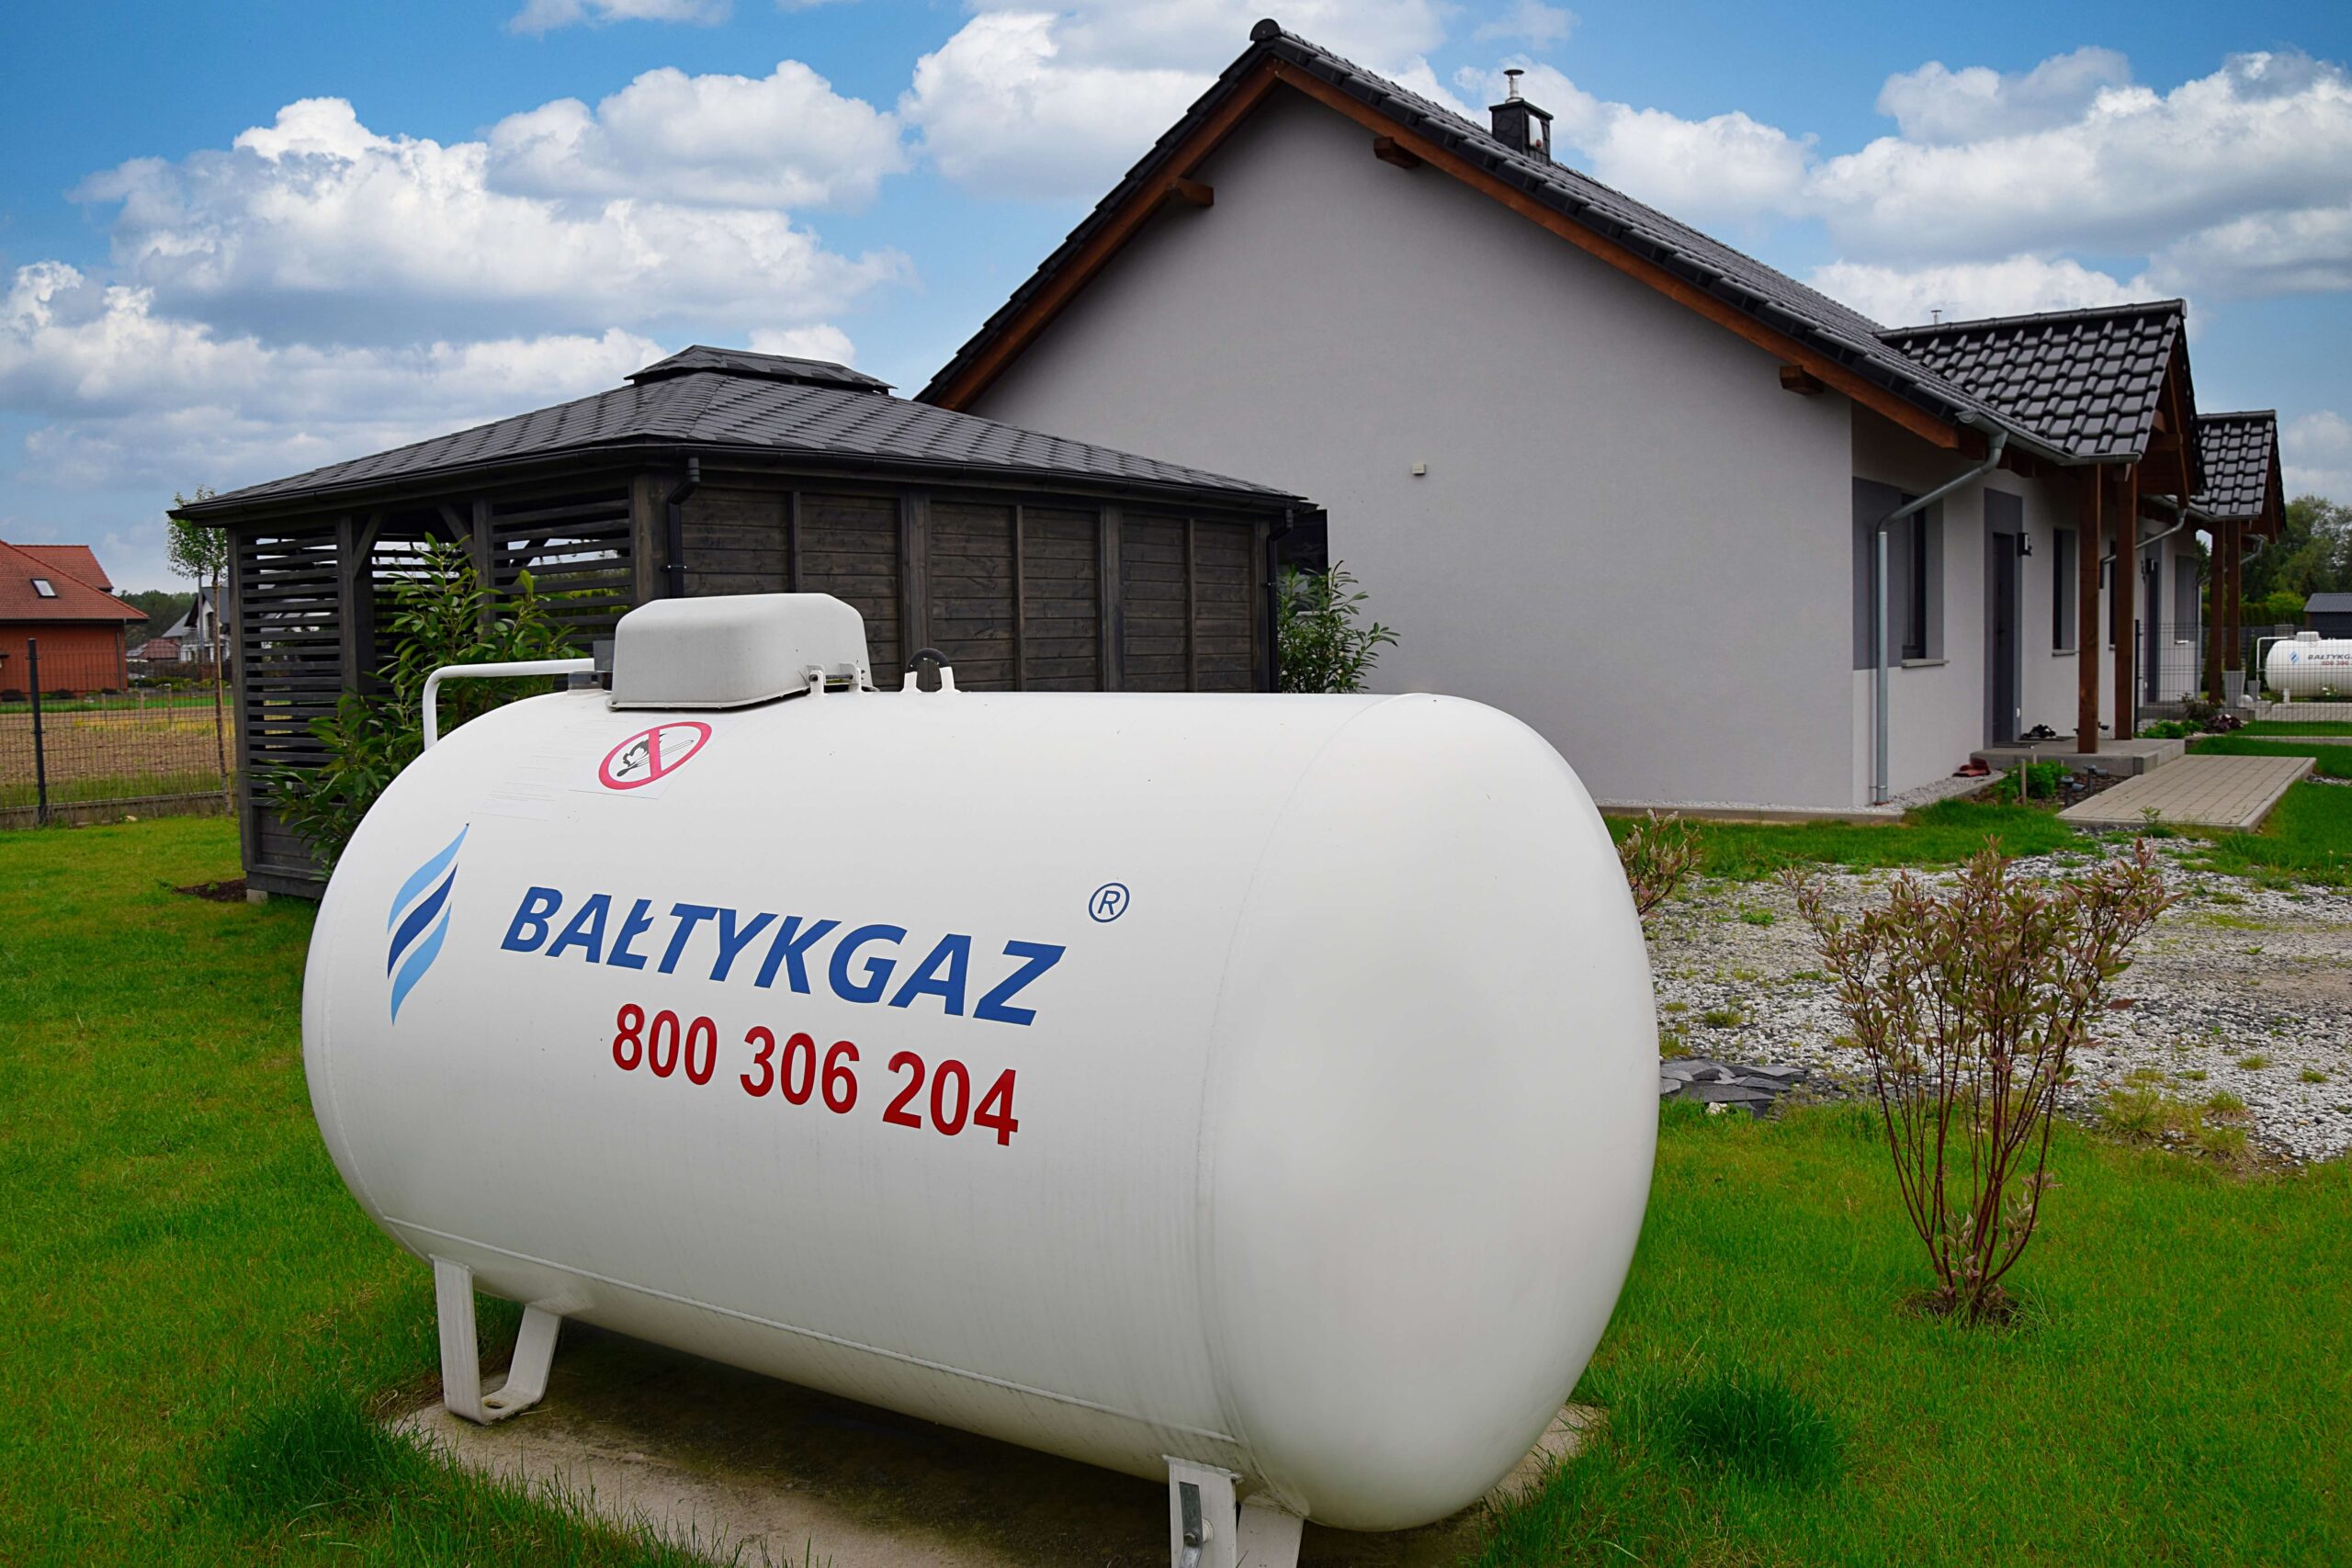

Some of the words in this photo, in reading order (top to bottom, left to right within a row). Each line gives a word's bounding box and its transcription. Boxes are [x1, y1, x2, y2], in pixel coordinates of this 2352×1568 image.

[501, 886, 1066, 1026] BAŁTYKGAZ
[612, 1002, 718, 1086] 800
[740, 1025, 860, 1114] 306
[882, 1050, 1019, 1146] 204
